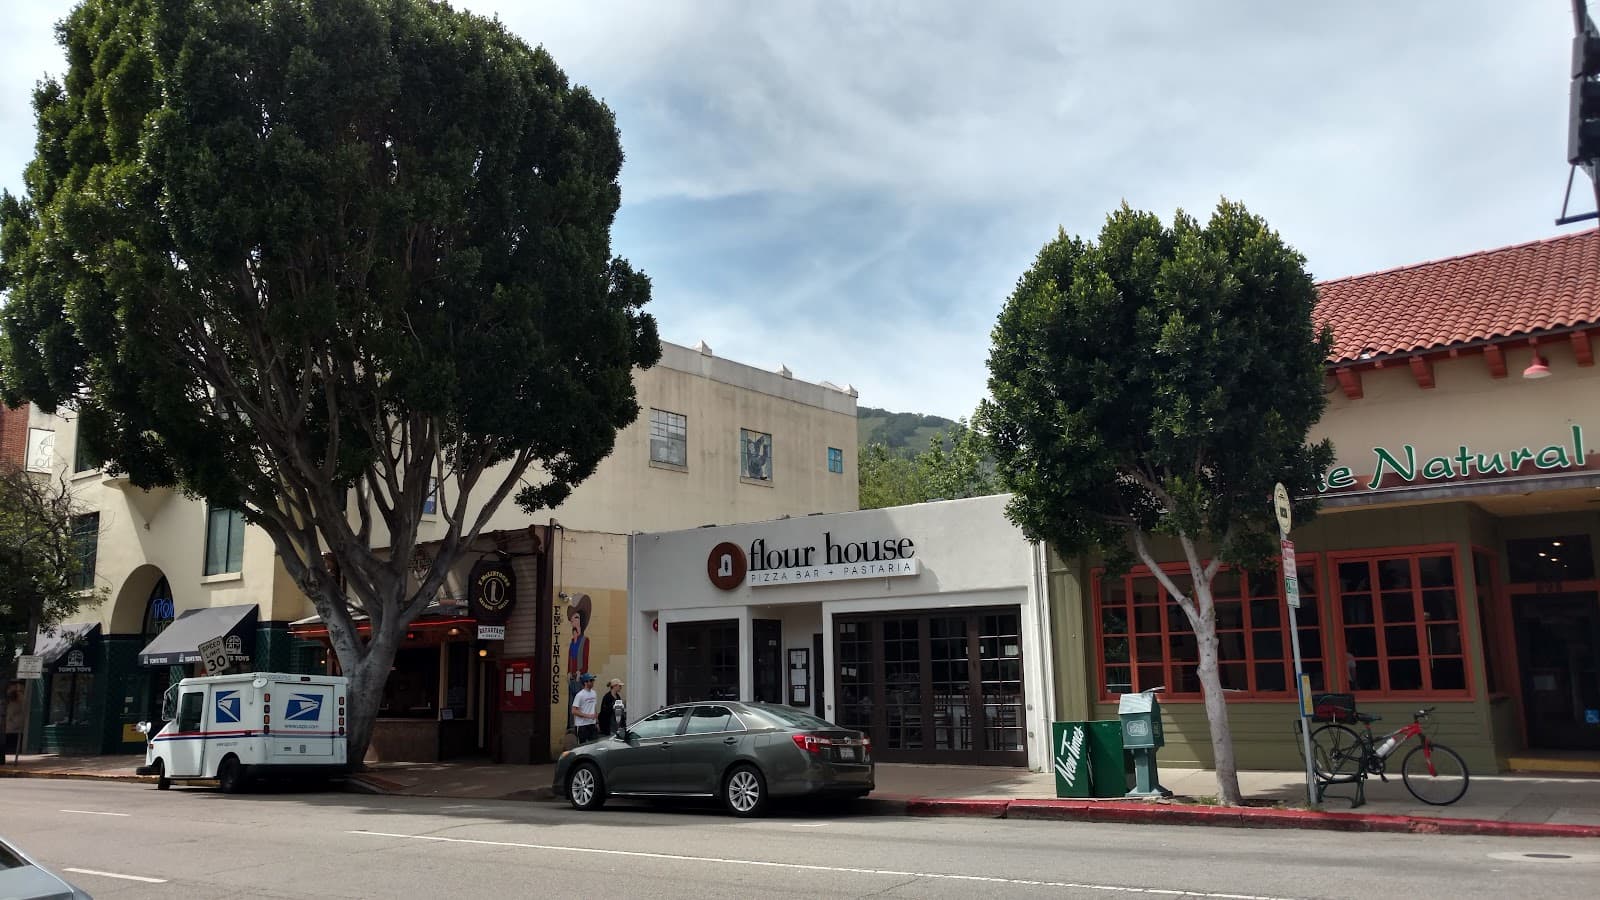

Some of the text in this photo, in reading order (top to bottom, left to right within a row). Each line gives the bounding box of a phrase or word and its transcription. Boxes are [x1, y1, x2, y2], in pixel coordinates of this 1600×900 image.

[1368, 425, 1585, 490] Natural
[749, 531, 915, 571] flour house
[751, 572, 788, 583] PIZZA
[796, 569, 819, 579] BAR
[844, 562, 911, 576] PASTARIA
[201, 640, 221, 650] SPEED
[205, 648, 221, 659] LIMIT
[207, 655, 226, 672] 30
[1055, 725, 1085, 788] New Times
